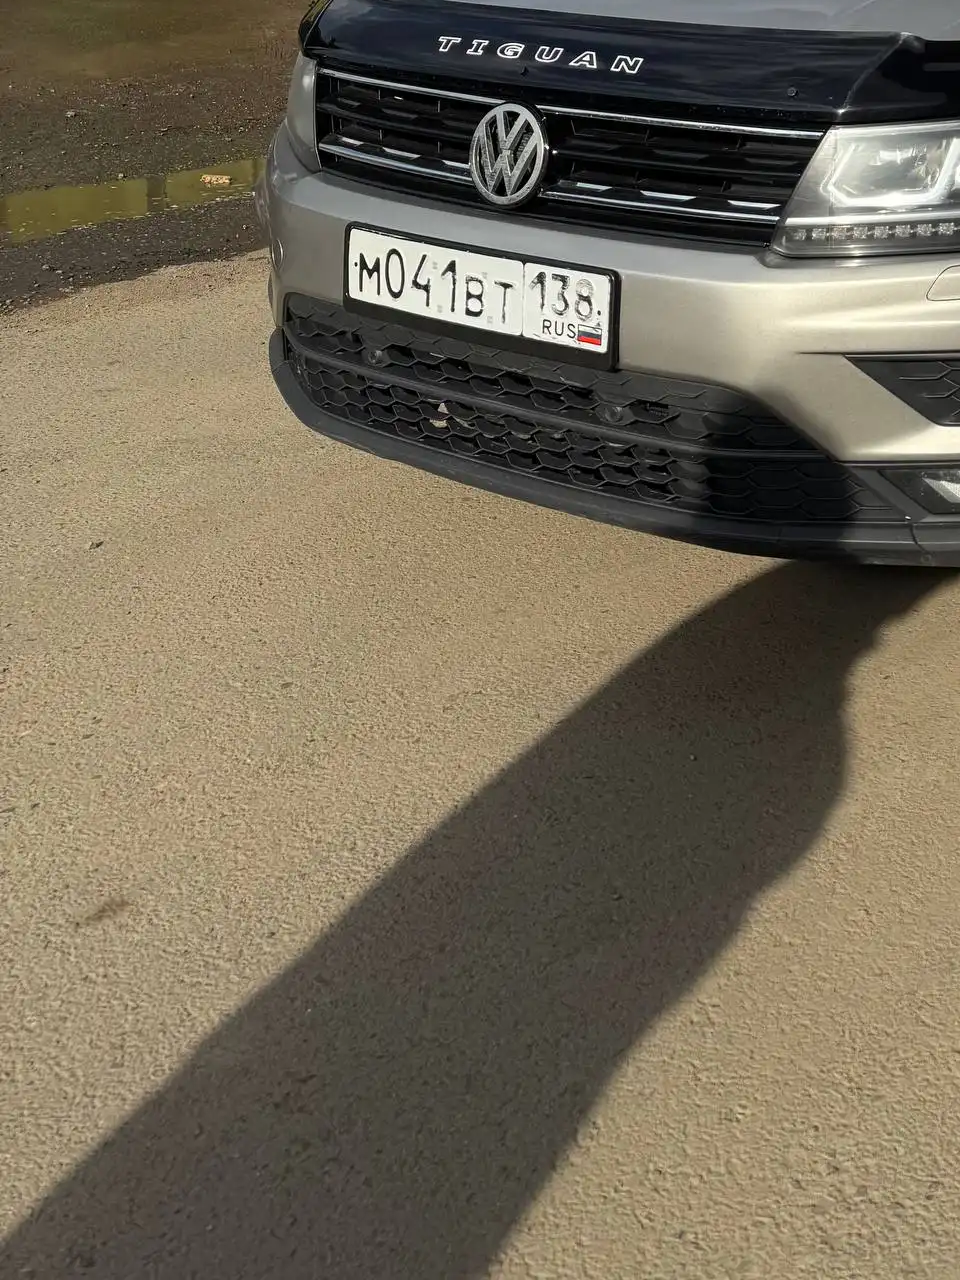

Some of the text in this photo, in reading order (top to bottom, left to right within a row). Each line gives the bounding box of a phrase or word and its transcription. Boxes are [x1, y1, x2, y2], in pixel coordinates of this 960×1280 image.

[437, 35, 645, 75] TIGUAN
[528, 270, 596, 322] 138
[541, 318, 577, 340] RUS
